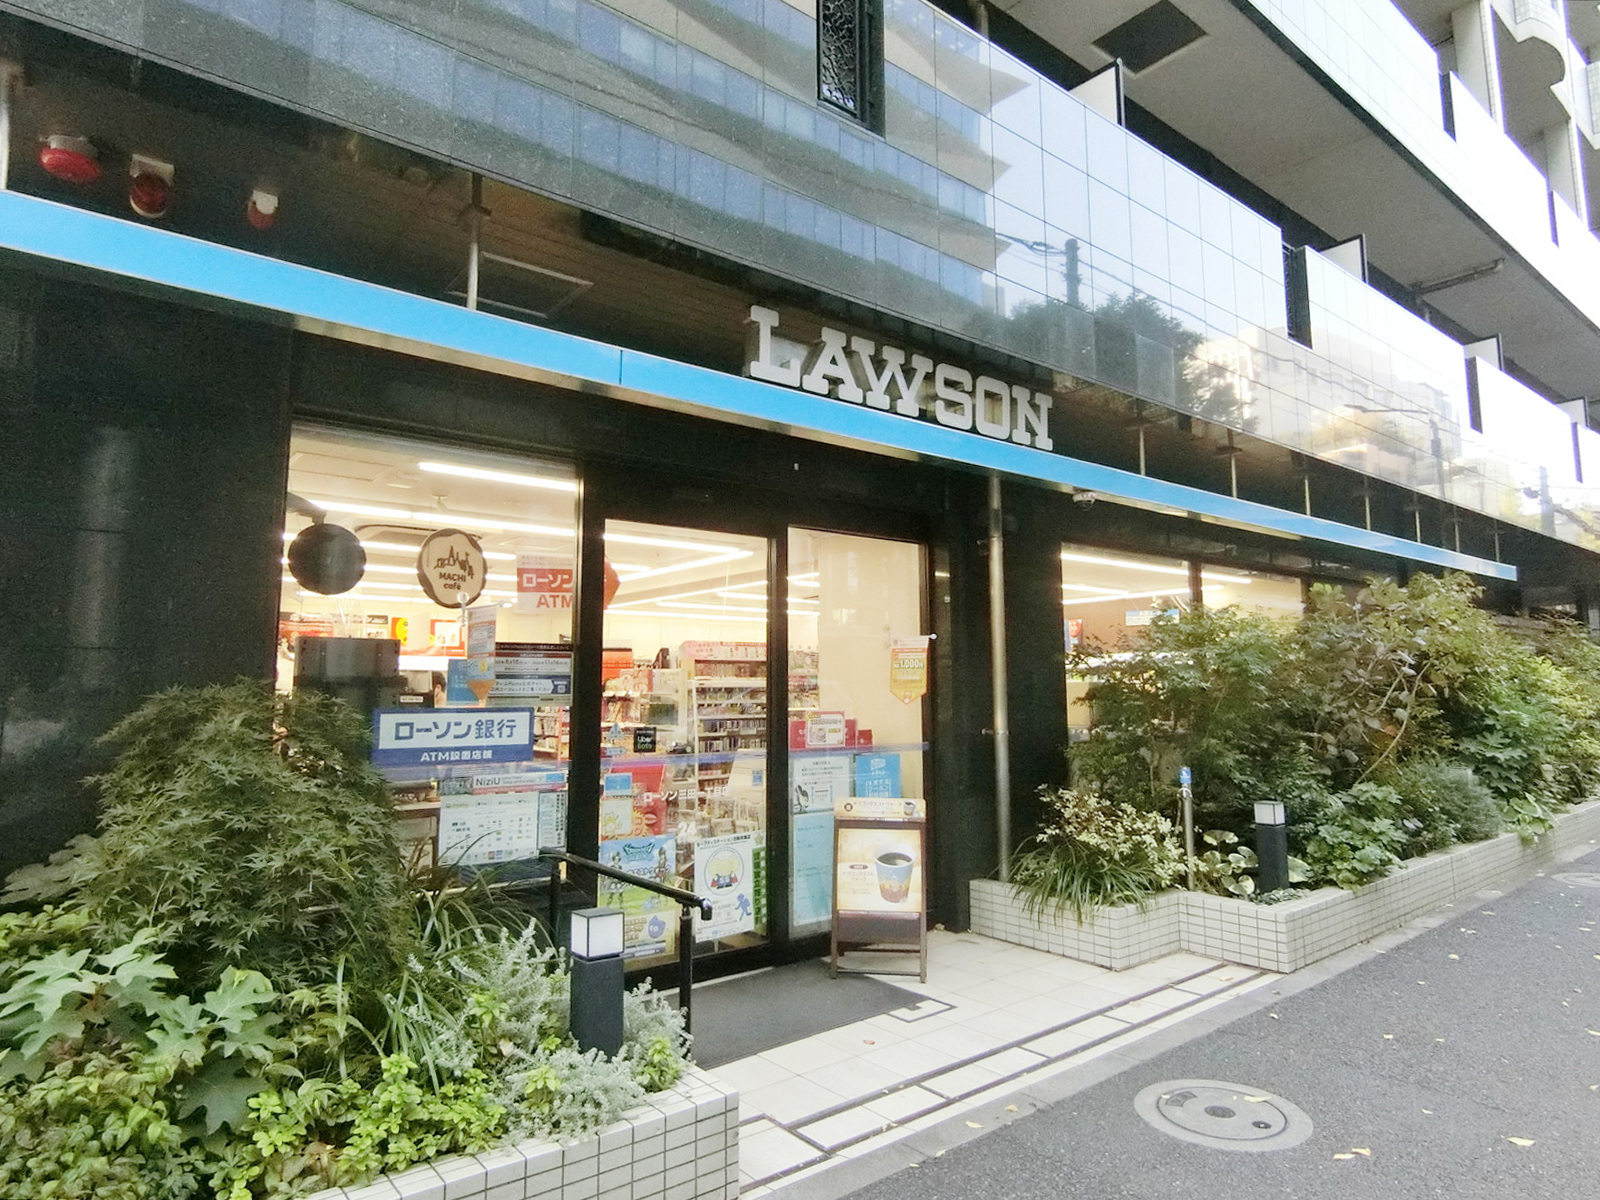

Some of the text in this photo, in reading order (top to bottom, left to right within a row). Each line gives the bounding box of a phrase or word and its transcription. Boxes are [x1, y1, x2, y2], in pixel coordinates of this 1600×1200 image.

[751, 305, 1053, 450] LAWSON
[439, 571, 467, 582] MACHI
[522, 573, 573, 588] ローソン
[536, 594, 573, 609] ATM
[394, 719, 516, 740] ローソン銀行
[420, 750, 493, 762] ATM設置店舗
[475, 777, 501, 786] NiziU
